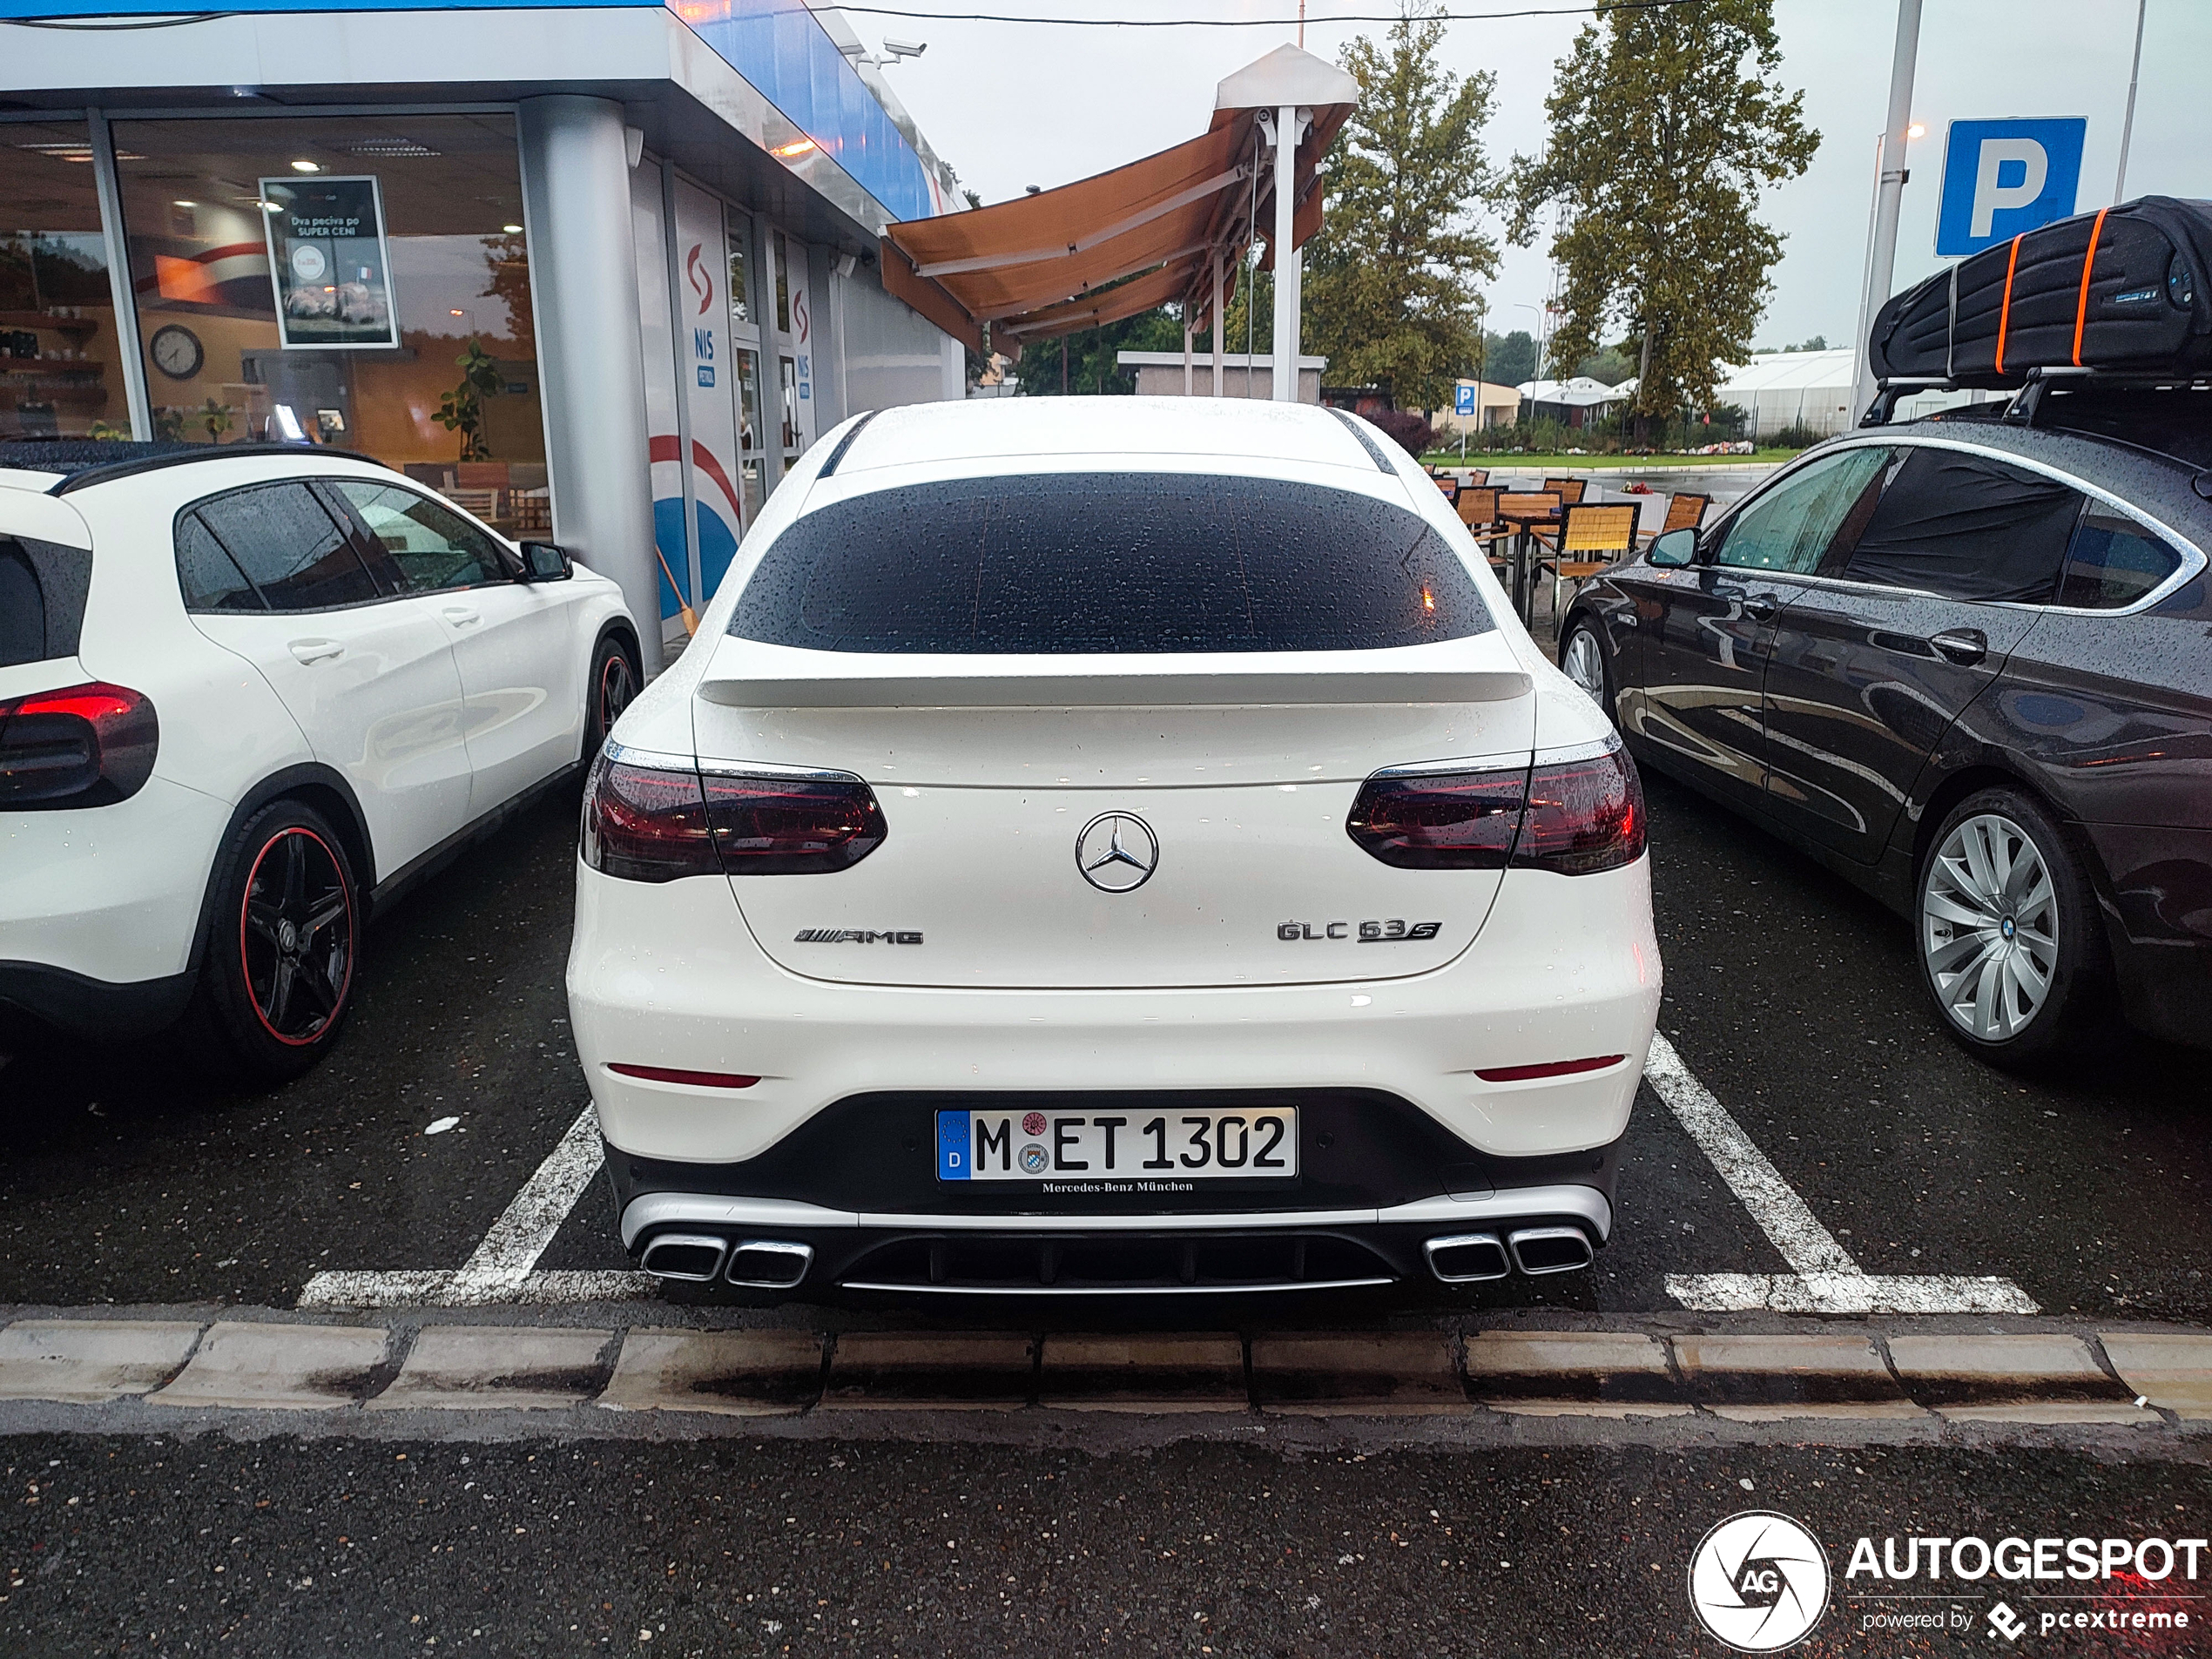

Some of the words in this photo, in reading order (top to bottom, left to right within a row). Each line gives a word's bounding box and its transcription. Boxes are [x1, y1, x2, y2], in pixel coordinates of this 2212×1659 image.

[1970, 138, 2047, 237] P
[291, 217, 310, 226] Dva
[312, 216, 344, 226] peciva
[346, 218, 360, 226] po
[298, 227, 330, 236] SUPER
[332, 227, 355, 236] CENI
[694, 327, 714, 360] NIS
[1460, 388, 1471, 404] P
[1278, 921, 1348, 941] GLC
[976, 1118, 1010, 1170] M
[1054, 1117, 1127, 1170] ET
[1143, 1116, 1285, 1169] 1302
[948, 1152, 961, 1168] D
[1042, 1183, 1133, 1193] Mercedes-Benz
[1136, 1182, 1193, 1192] München
